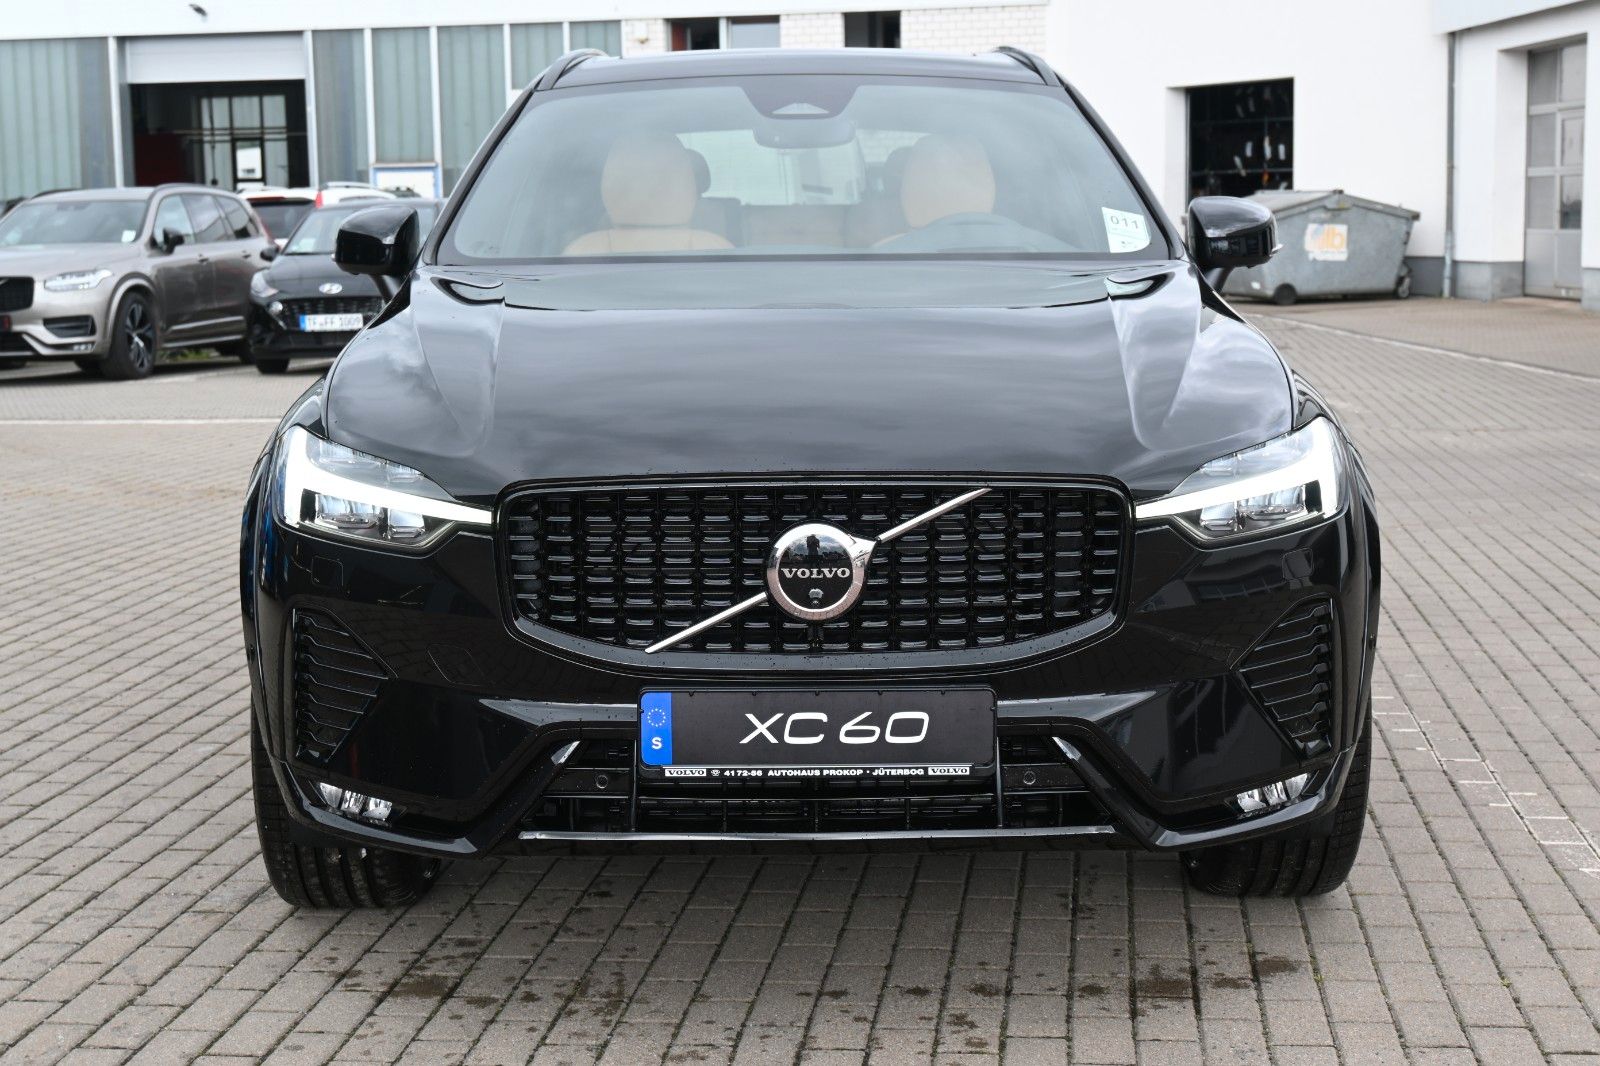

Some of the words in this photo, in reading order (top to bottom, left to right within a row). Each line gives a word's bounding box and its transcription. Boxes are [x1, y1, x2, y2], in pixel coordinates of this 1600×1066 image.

[1110, 215, 1138, 229] 011
[780, 567, 851, 579] VOLVO
[739, 712, 828, 745] XC
[839, 711, 930, 744] 60
[652, 736, 662, 750] S
[667, 768, 706, 777] VOLVO
[767, 769, 821, 777] AUTOHAUS
[823, 768, 864, 776] PROKOP
[872, 767, 925, 776] JÜTERBOG
[930, 767, 968, 775] VOLVO
